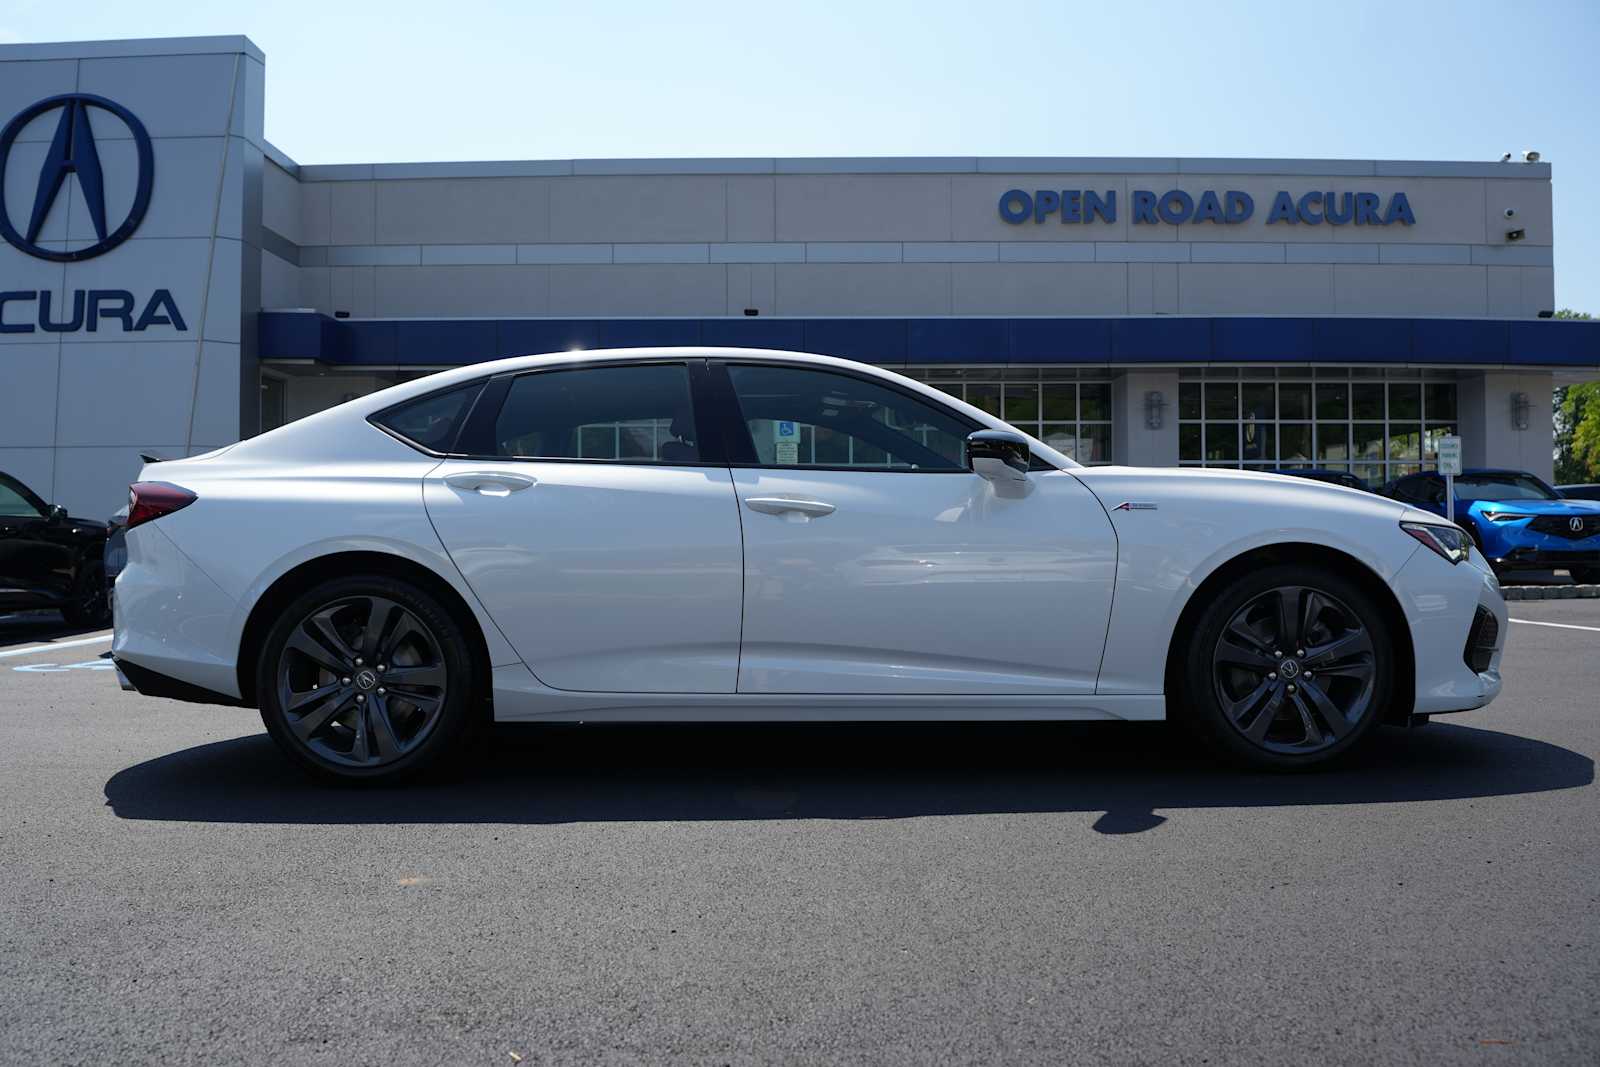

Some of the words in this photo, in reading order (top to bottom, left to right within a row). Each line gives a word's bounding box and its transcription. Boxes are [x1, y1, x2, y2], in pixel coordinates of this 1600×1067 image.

[999, 189, 1117, 225] OPEN
[1131, 189, 1255, 226] ROAD
[1265, 190, 1416, 226] ACURA
[0, 289, 188, 333] CURA
